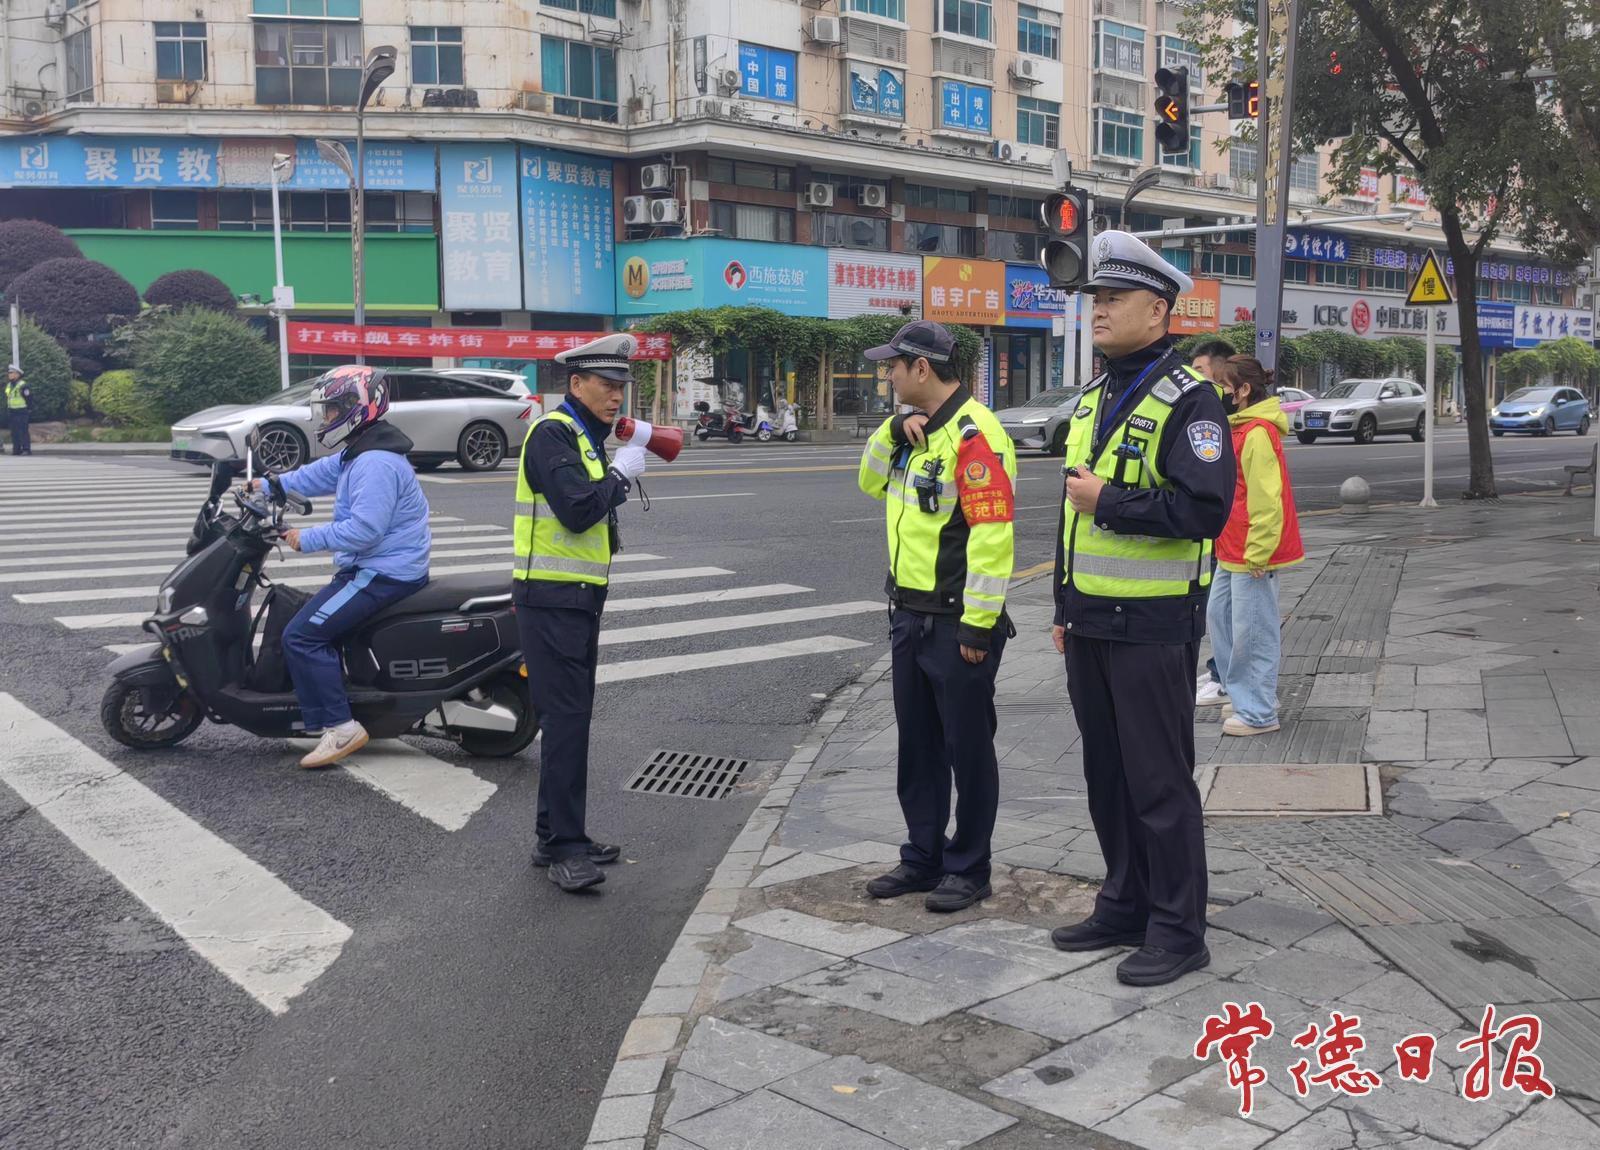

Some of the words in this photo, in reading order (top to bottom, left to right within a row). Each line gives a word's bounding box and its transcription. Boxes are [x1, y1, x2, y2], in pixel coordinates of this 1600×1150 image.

[83, 145, 213, 182] 聚贤教
[547, 160, 612, 189] 聚贤教育
[447, 211, 511, 243] 聚贤
[448, 250, 513, 281] 教育
[629, 264, 643, 286] M
[1422, 277, 1436, 296] 慢
[1313, 305, 1348, 326] ICBC
[1130, 416, 1154, 430] 100571
